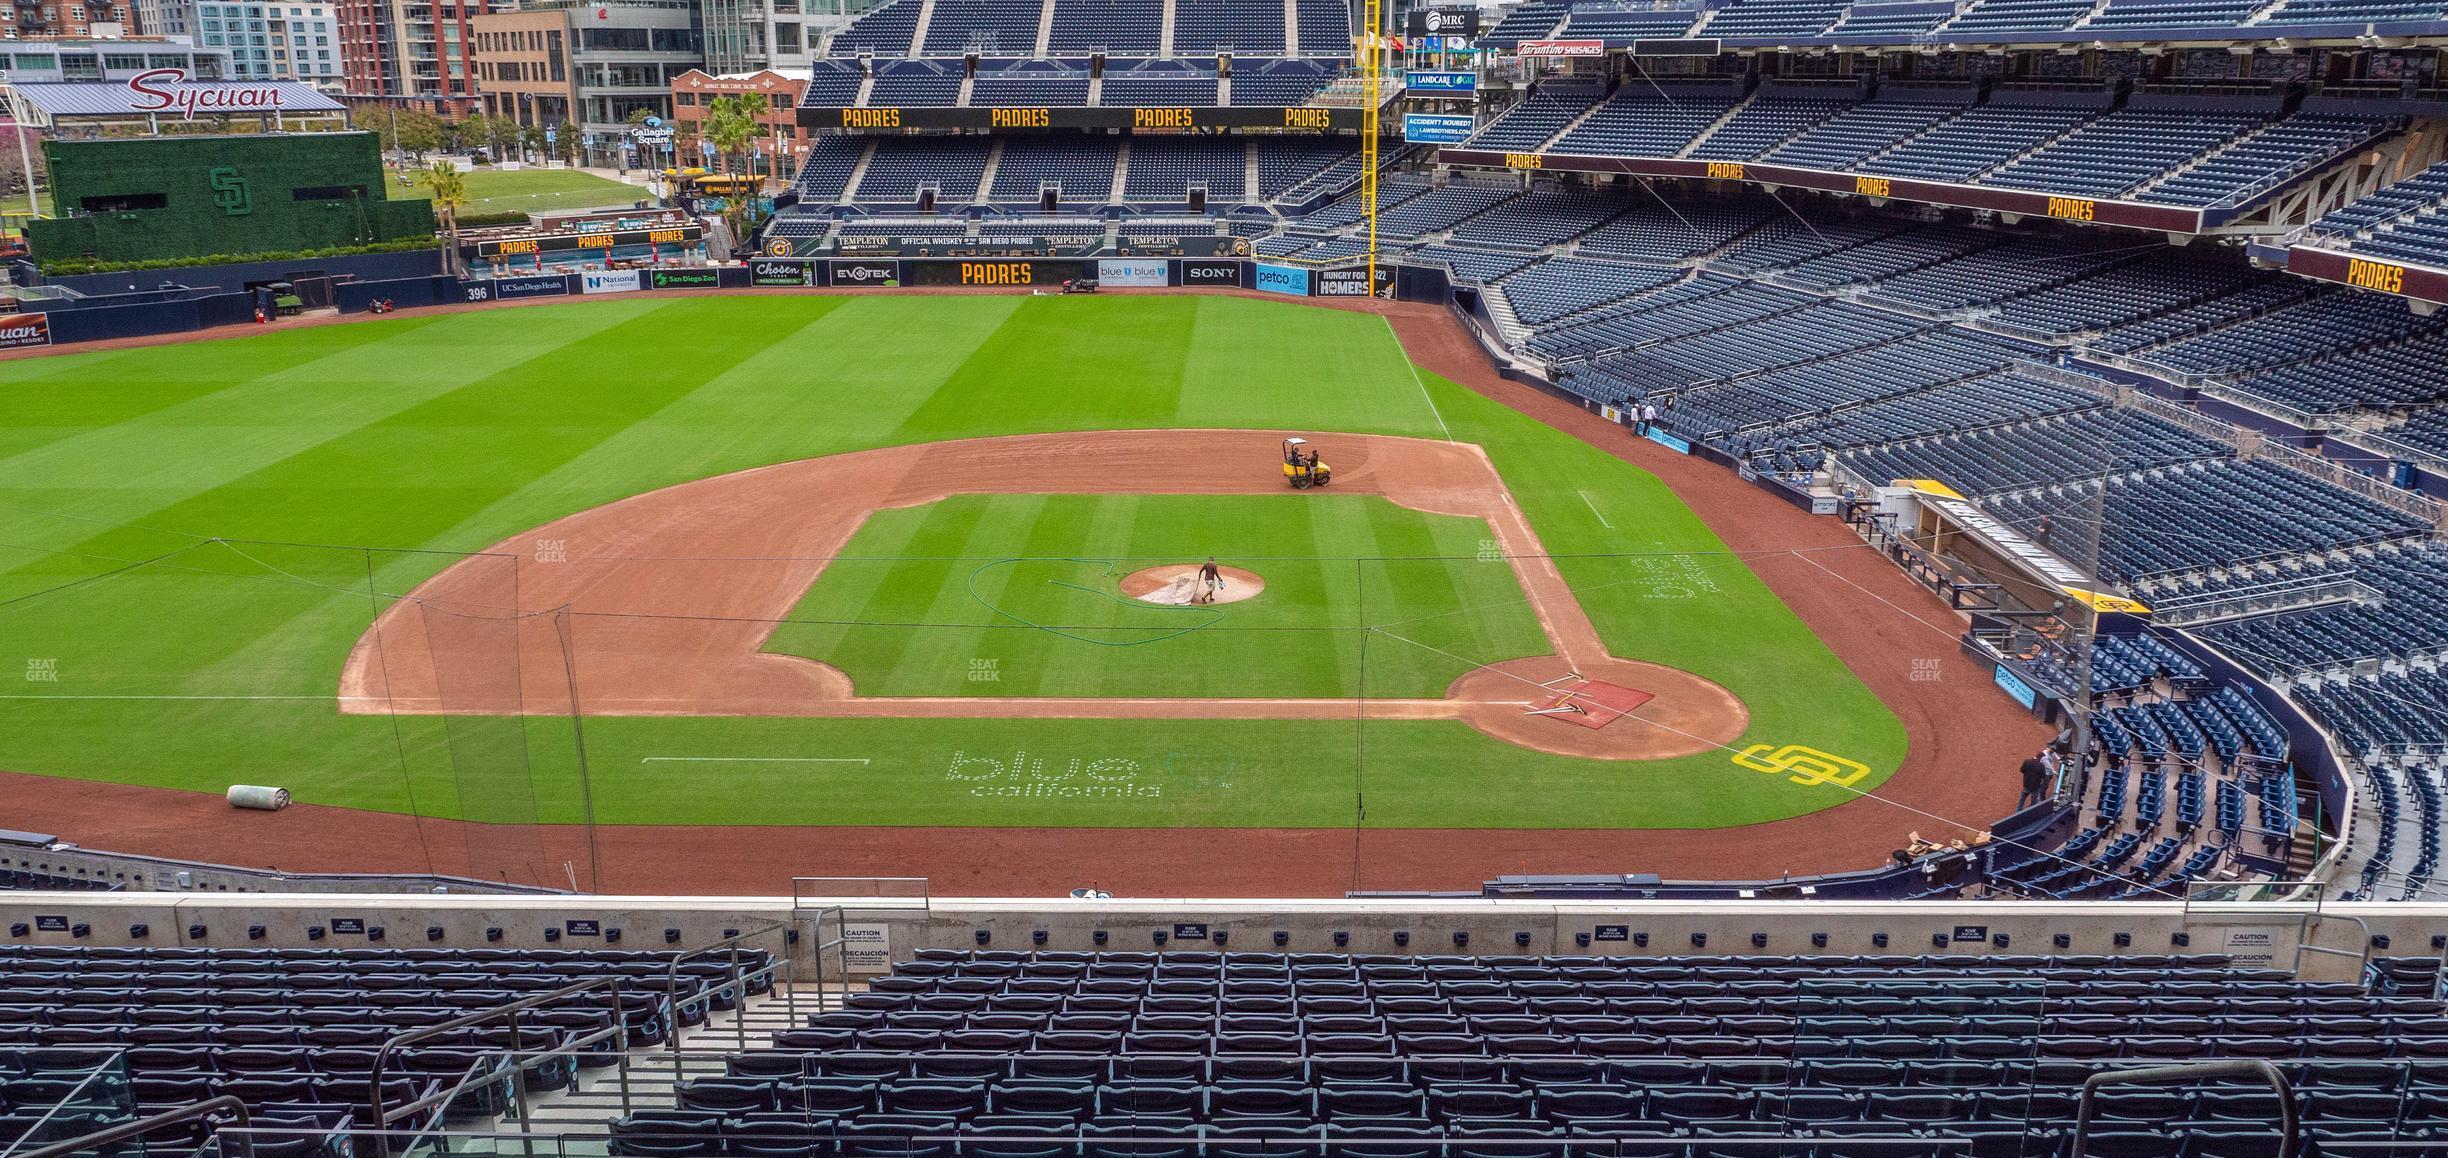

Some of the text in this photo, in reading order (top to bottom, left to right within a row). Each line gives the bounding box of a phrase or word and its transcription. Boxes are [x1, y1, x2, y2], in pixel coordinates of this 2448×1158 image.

[1441, 15, 1465, 25] MRC
[1520, 42, 1600, 54] Tarantino SAUSAGES
[1418, 76, 1451, 84] LANDCARE
[129, 68, 285, 121] Sycuan
[843, 109, 900, 127] PADRES
[992, 109, 1049, 127] PADRES
[1135, 109, 1192, 127] PADRES
[1285, 109, 1330, 127] PADRES
[631, 128, 674, 138] Gallagher
[638, 136, 669, 145] Square
[1505, 153, 1542, 169] PADRES
[1707, 162, 1744, 179] PADRES
[1856, 176, 1890, 197] PADRES
[2048, 197, 2094, 221] PADRES
[578, 235, 613, 248] PADRES
[650, 230, 684, 243] PADRES
[838, 236, 889, 246] TEMPLETON
[1128, 237, 1179, 246] TEMPLETON
[500, 240, 537, 255] PADRES
[756, 262, 800, 275] Chosen
[837, 267, 892, 281] EVOTEK
[961, 263, 1032, 285] PADRES
[1101, 266, 1122, 276] blue
[1134, 267, 1156, 276] blue
[1190, 268, 1235, 278] SONY
[1374, 269, 1387, 281] 322
[602, 275, 636, 283] National
[1259, 270, 1290, 288] petco
[1323, 271, 1366, 280] HUNGRY FOR
[2347, 258, 2404, 293] PADRES
[502, 281, 562, 292] UC San Diego Health
[1320, 280, 1369, 295] HOMERS
[468, 287, 488, 300] 396
[946, 751, 1139, 782] blue
[971, 783, 1162, 797] california
